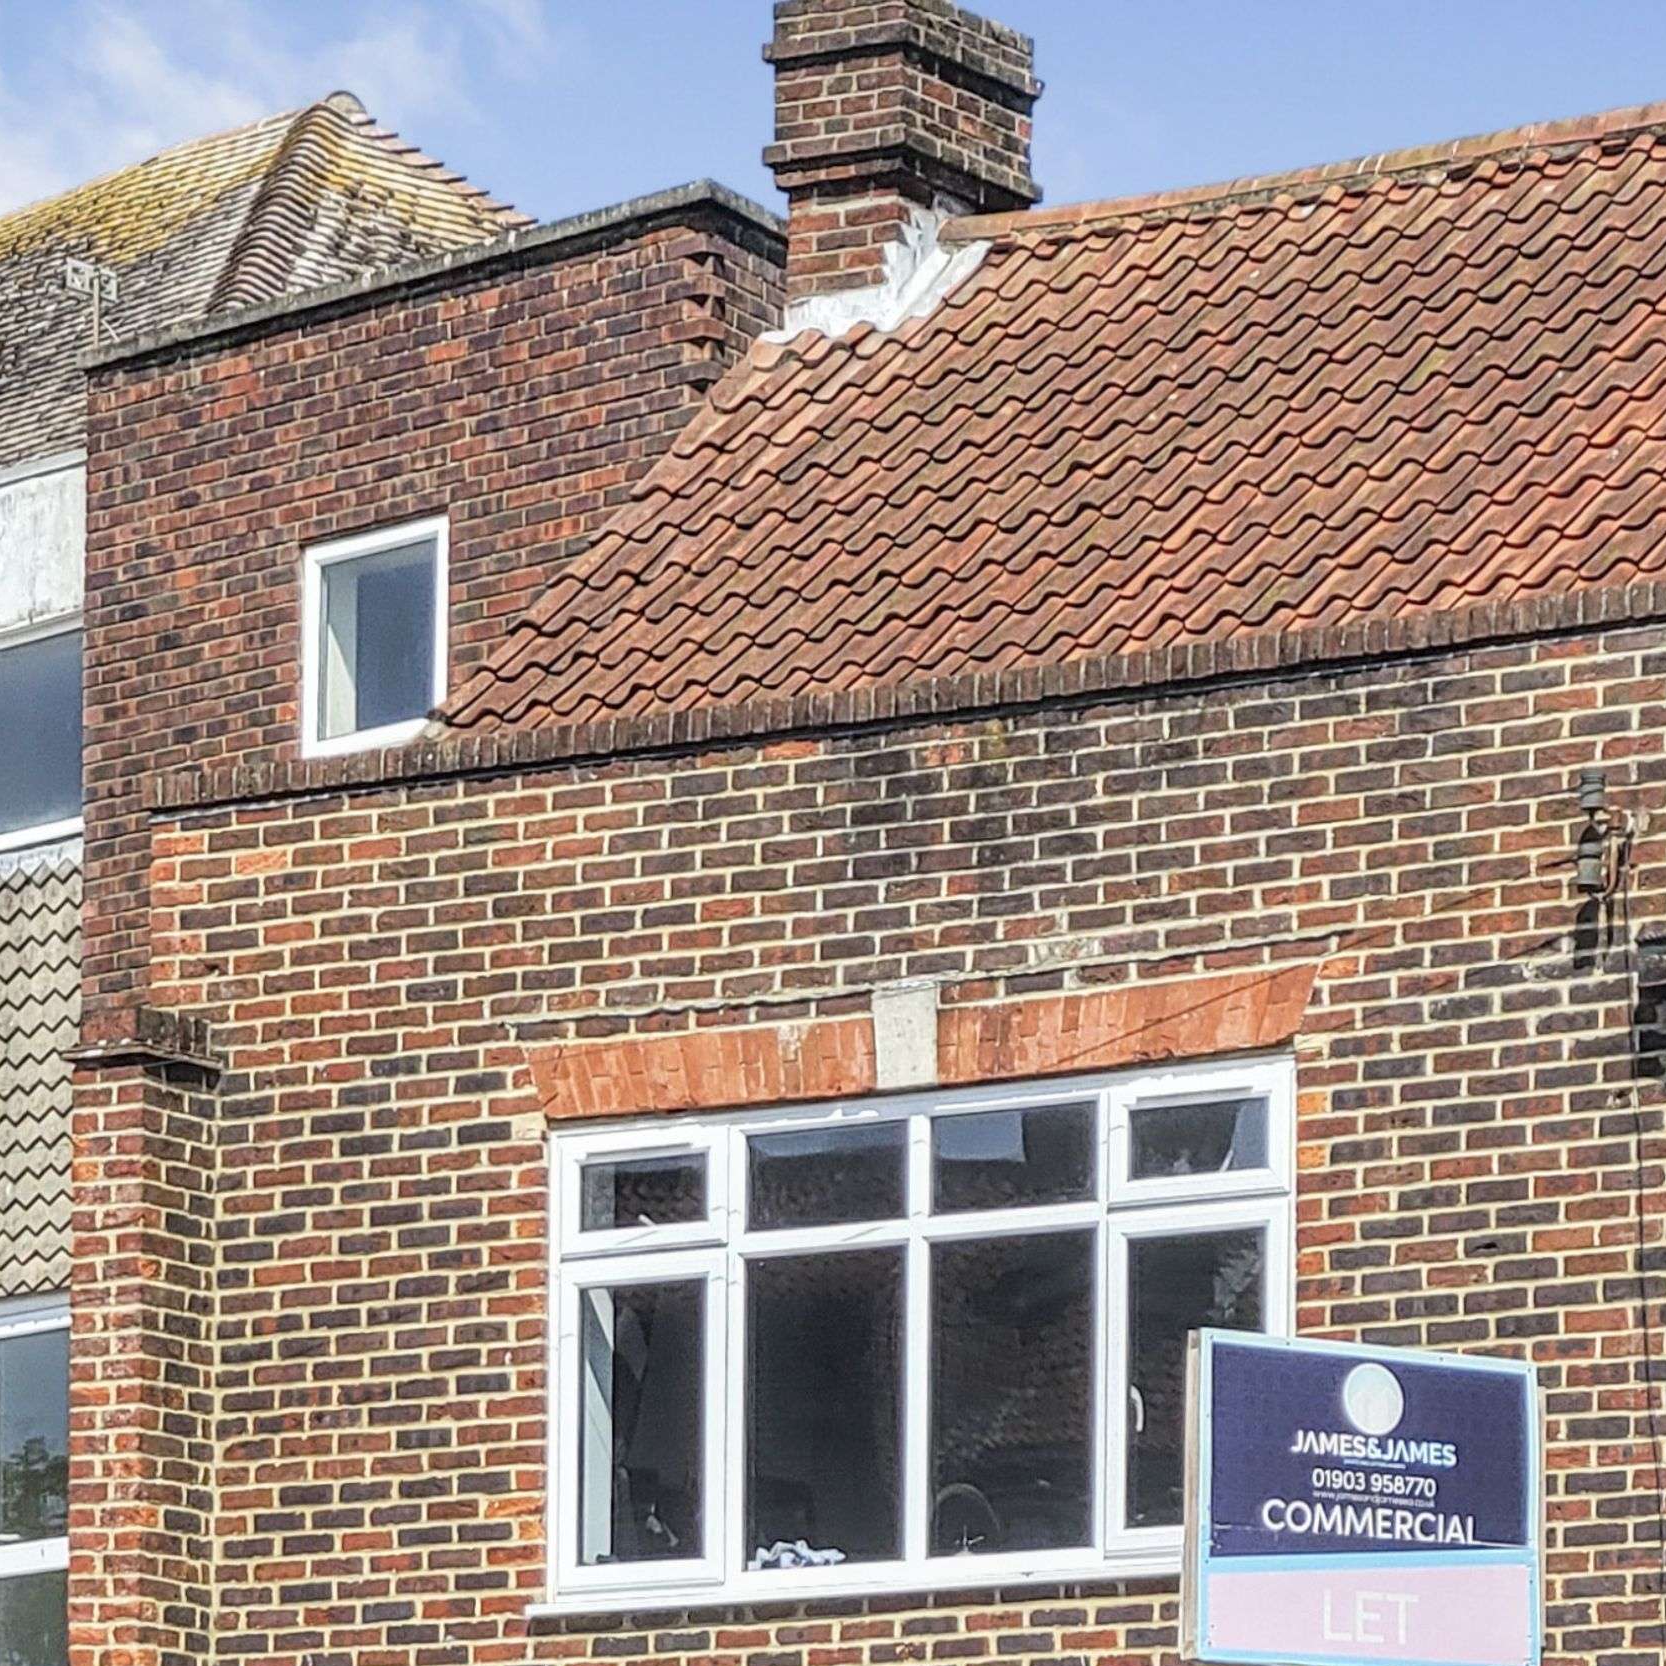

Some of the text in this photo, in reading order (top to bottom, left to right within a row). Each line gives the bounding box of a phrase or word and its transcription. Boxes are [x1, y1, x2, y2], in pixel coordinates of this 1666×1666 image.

[1290, 1429, 1458, 1468] JAMES&JAMES
[1312, 1468, 1437, 1498] 01903 958770
[1262, 1498, 1480, 1544] COMMERCIAL
[1323, 1589, 1420, 1645] LET
